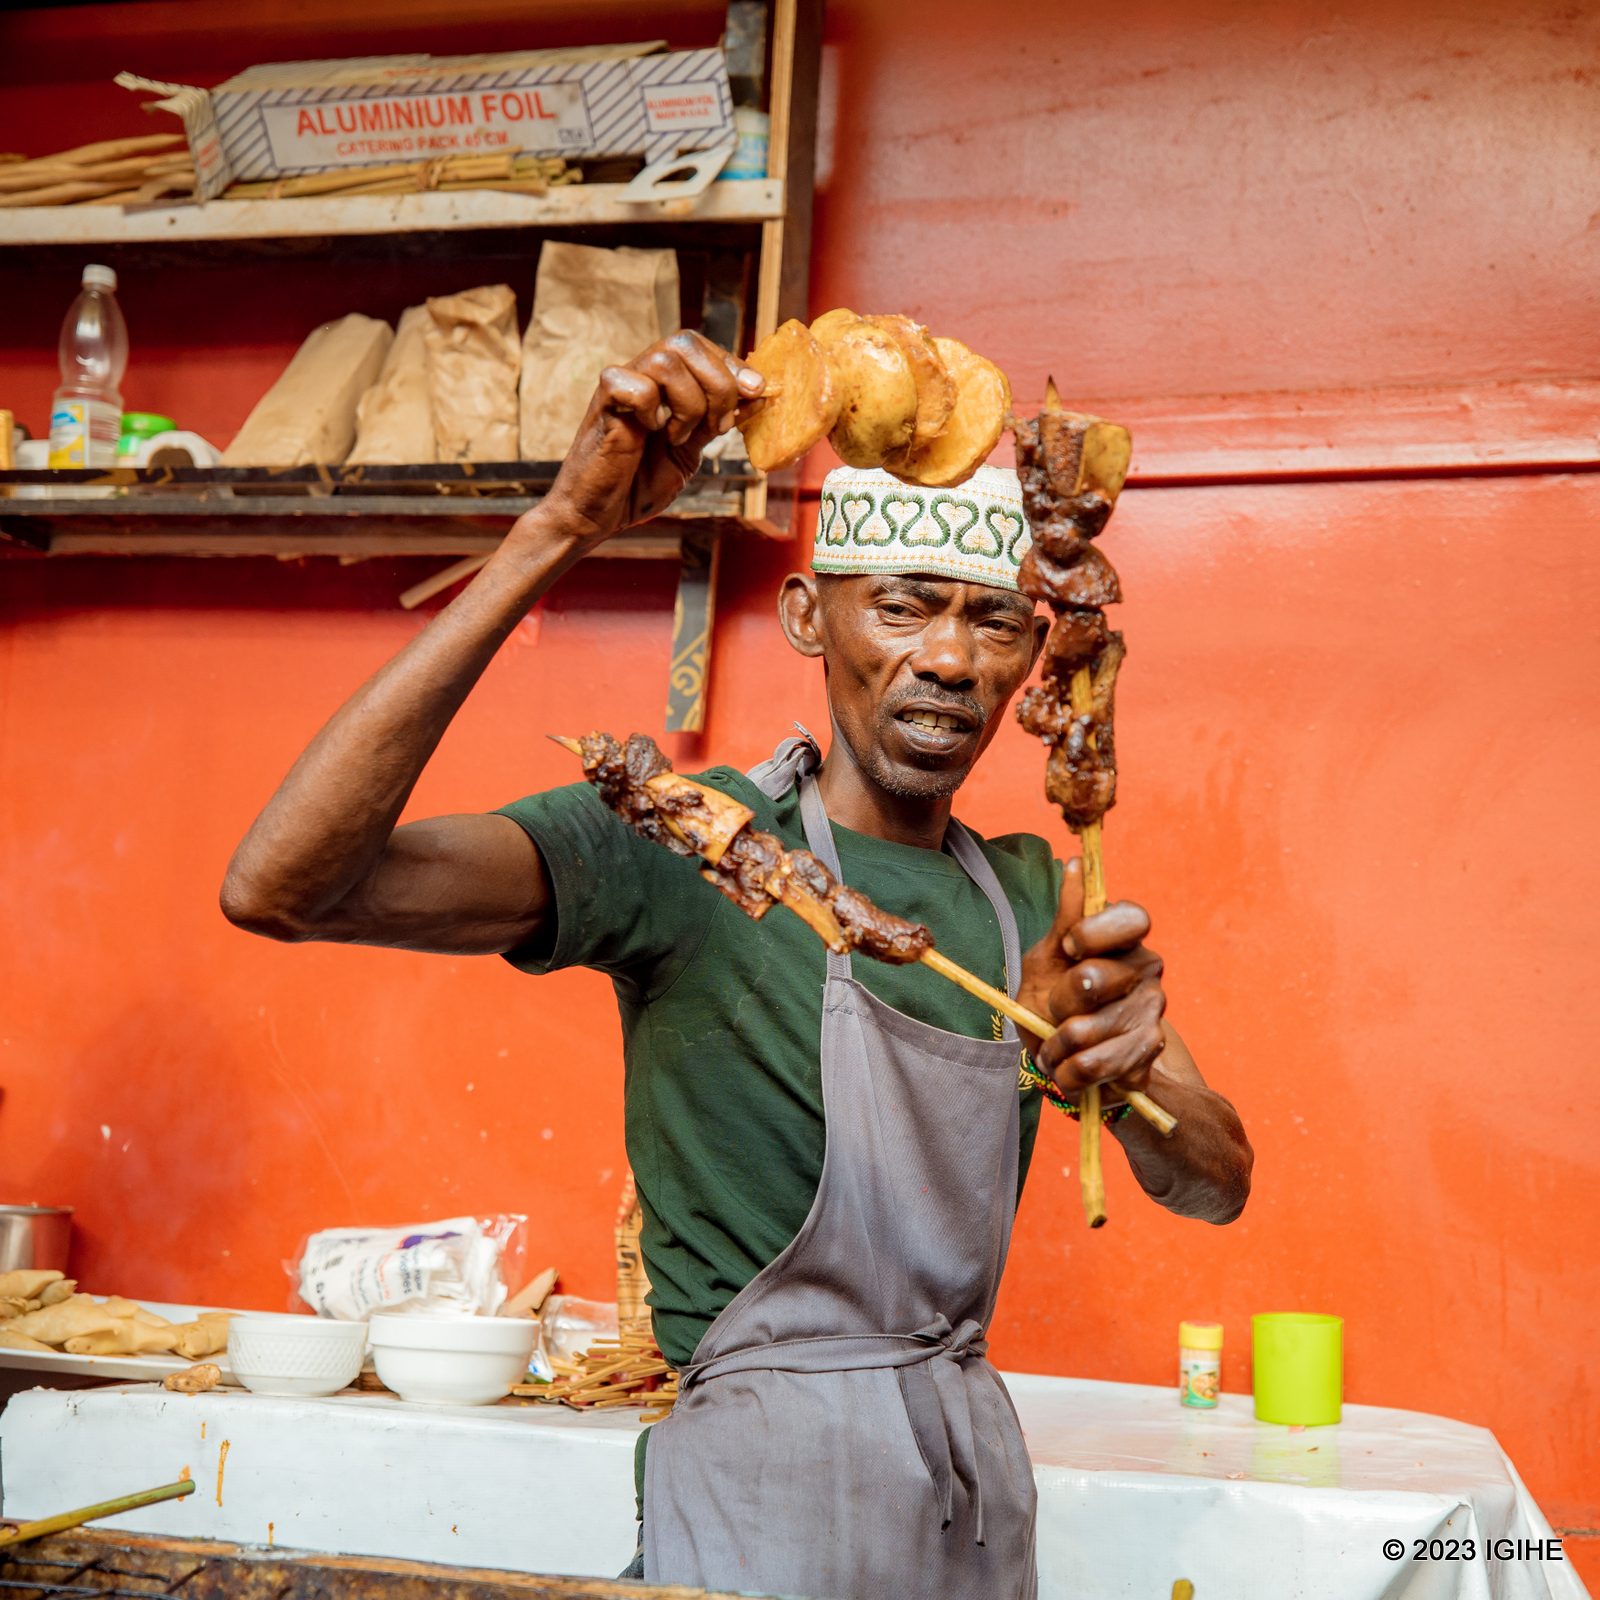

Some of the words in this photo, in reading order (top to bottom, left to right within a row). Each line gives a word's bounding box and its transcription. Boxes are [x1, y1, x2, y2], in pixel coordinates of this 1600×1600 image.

[297, 96, 473, 137] ALUMINIUM
[481, 90, 556, 123] FOIL
[336, 137, 414, 156] CATERING
[417, 134, 460, 149] PACK
[484, 131, 508, 145] CM
